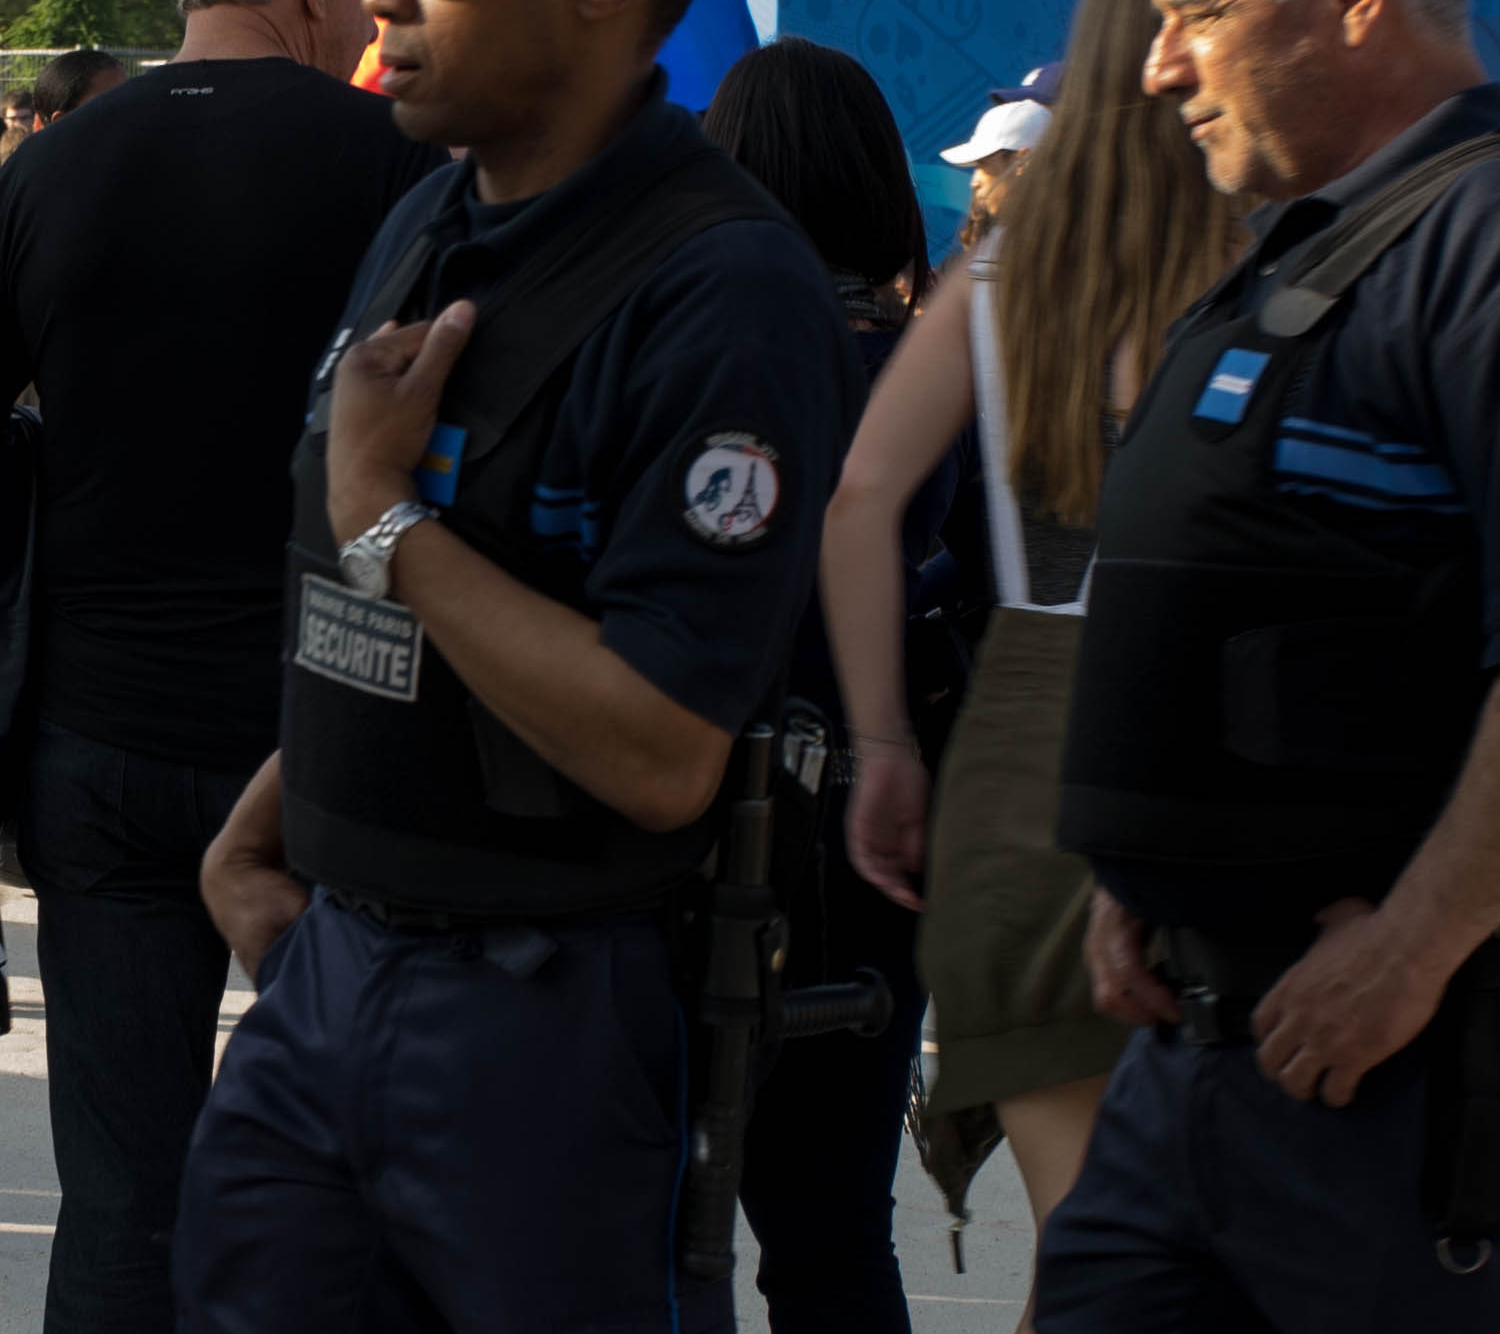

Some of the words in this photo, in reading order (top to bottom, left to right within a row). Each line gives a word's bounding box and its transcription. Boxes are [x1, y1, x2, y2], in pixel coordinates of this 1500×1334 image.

[346, 603, 366, 626] DE
[366, 611, 413, 640] PARIS
[303, 612, 411, 689] SECURITE
